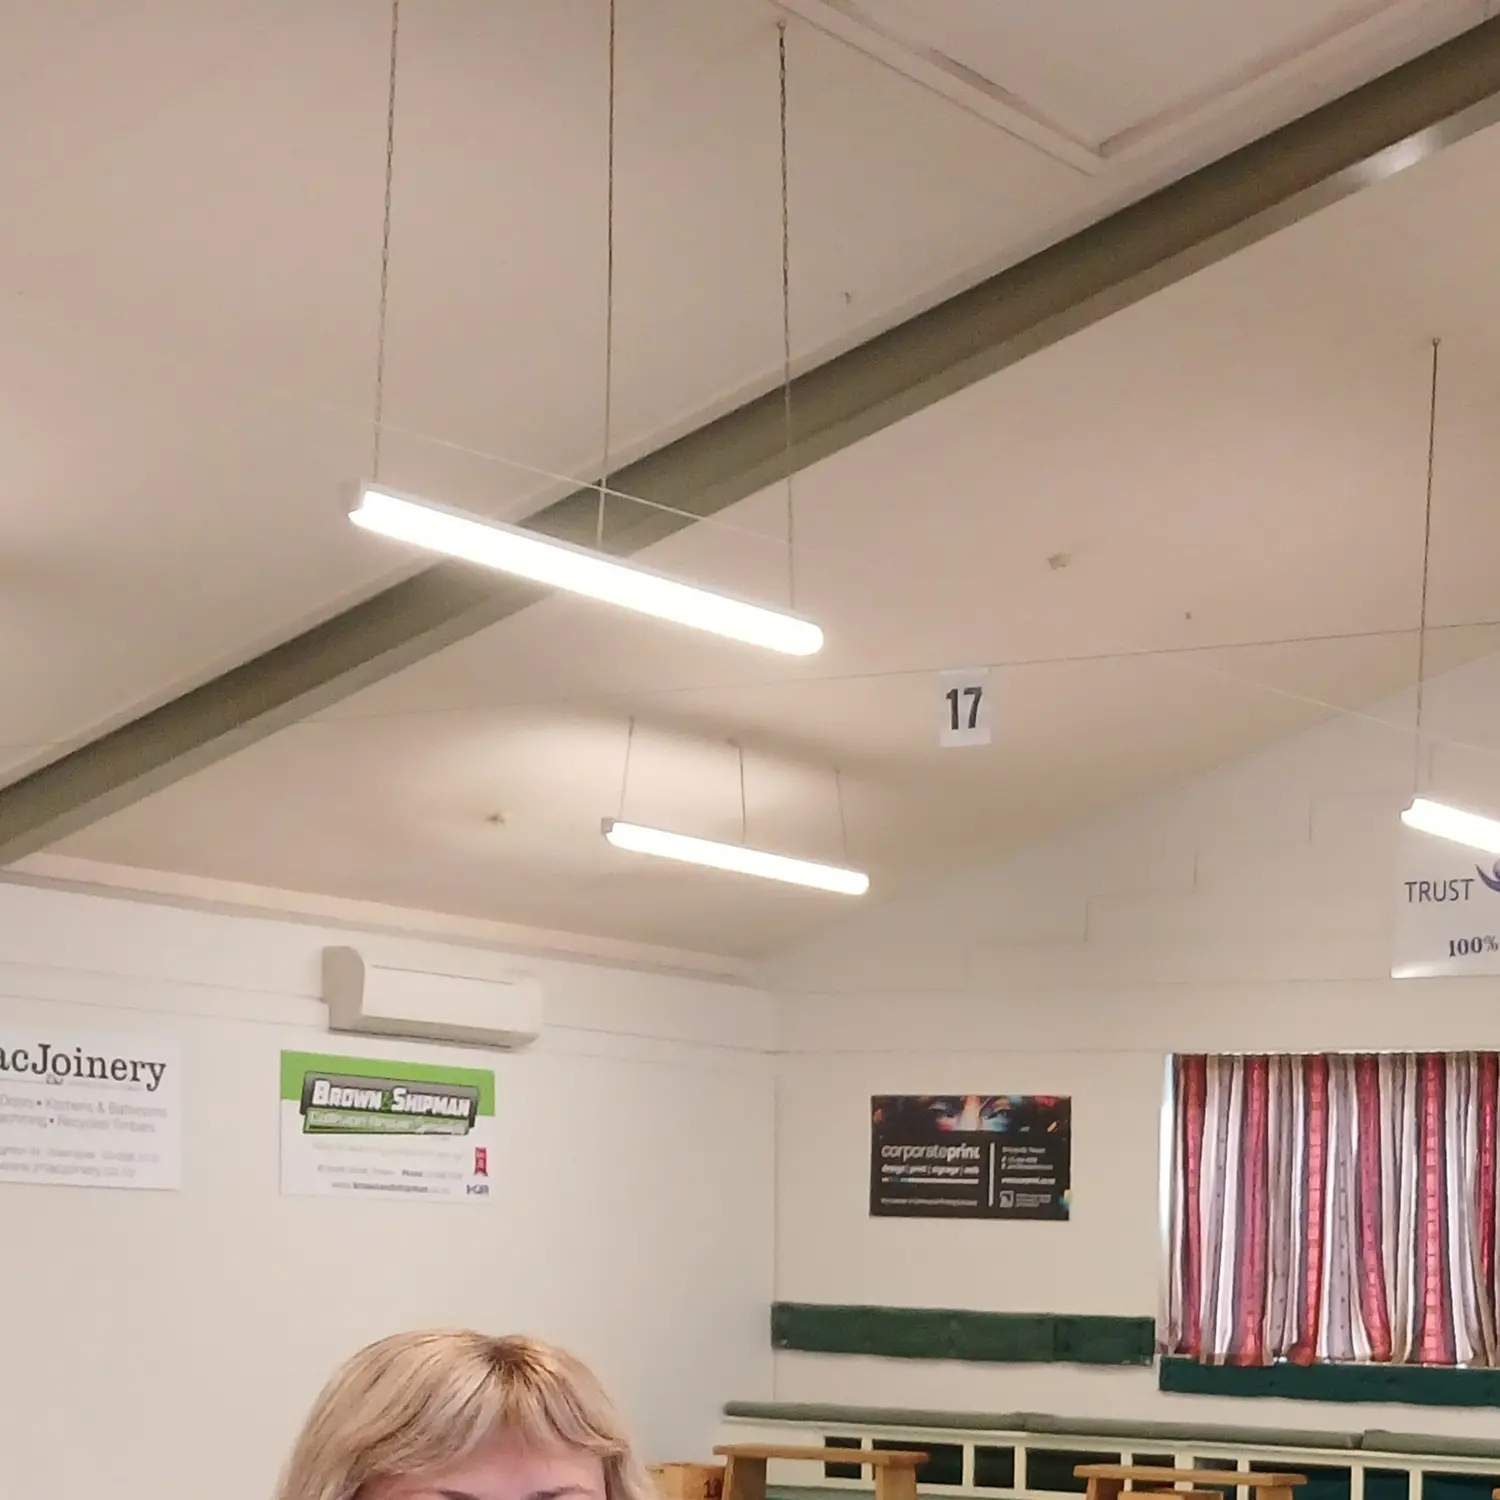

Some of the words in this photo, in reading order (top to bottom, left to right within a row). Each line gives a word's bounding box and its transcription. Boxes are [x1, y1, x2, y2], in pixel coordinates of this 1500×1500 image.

[945, 686, 983, 730] 17
[1404, 878, 1474, 903] TRUST
[1448, 935, 1499, 957] 100%
[312, 1079, 382, 1110] BROWN
[391, 1087, 471, 1117] SHIPMAN
